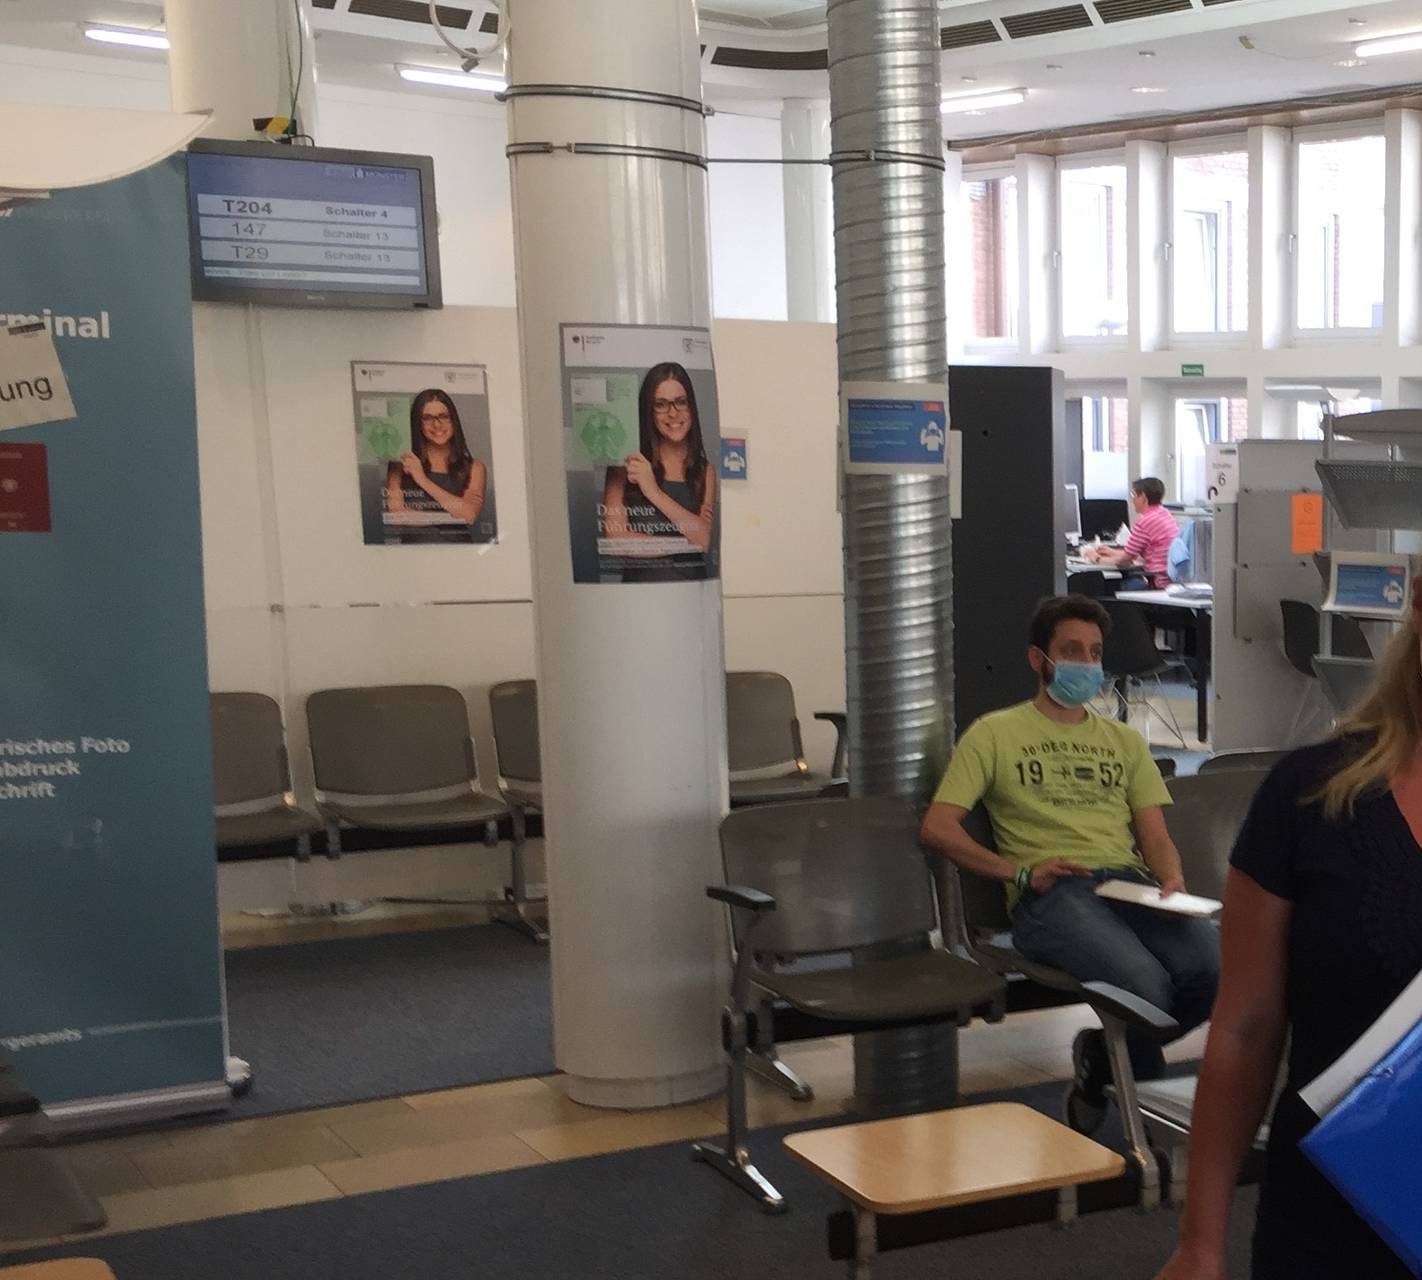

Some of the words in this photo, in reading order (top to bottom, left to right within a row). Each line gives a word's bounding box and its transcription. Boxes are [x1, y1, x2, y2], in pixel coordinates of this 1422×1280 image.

[222, 199, 272, 215] T204
[325, 206, 377, 218] Schalter
[381, 209, 388, 219] 4
[231, 221, 266, 237] 147
[323, 228, 371, 241] Schalter
[231, 245, 269, 261] T29
[624, 505, 656, 516] neue
[80, 736, 130, 754] Foto
[1072, 741, 1115, 759] NORTH
[1014, 759, 1044, 787] 19
